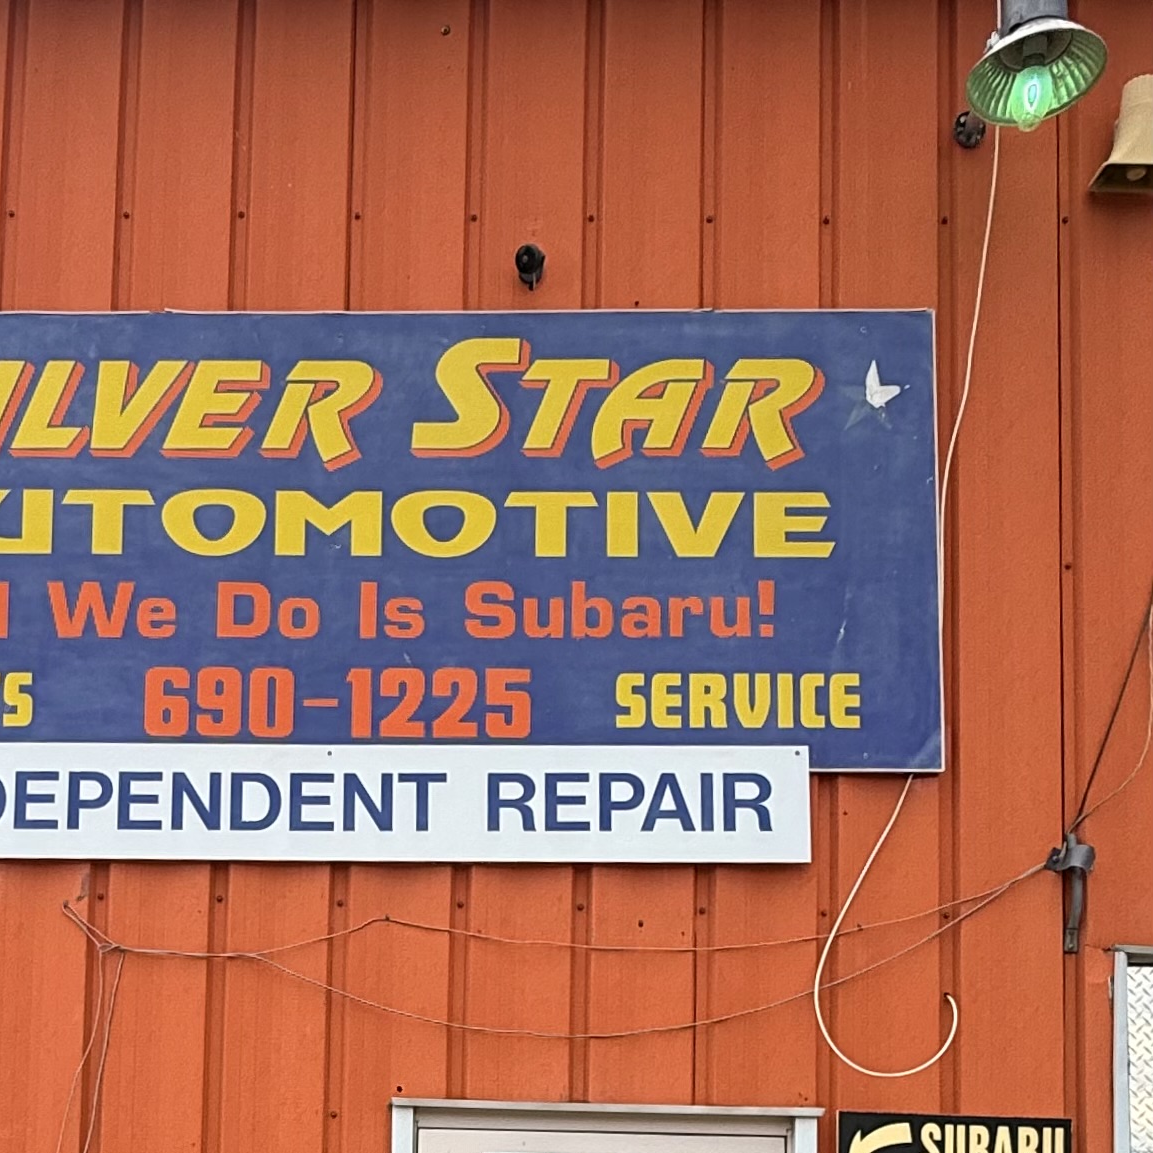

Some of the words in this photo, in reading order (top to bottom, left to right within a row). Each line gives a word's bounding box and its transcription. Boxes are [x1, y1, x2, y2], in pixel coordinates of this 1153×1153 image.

[410, 337, 824, 470] STAR
[47, 581, 177, 639] We
[216, 581, 320, 639] Do
[359, 581, 425, 639] Is
[464, 580, 775, 639] Subaru!
[144, 667, 532, 738] 690-1225
[615, 672, 861, 729] SERVICE
[486, 772, 773, 832] REPAIR
